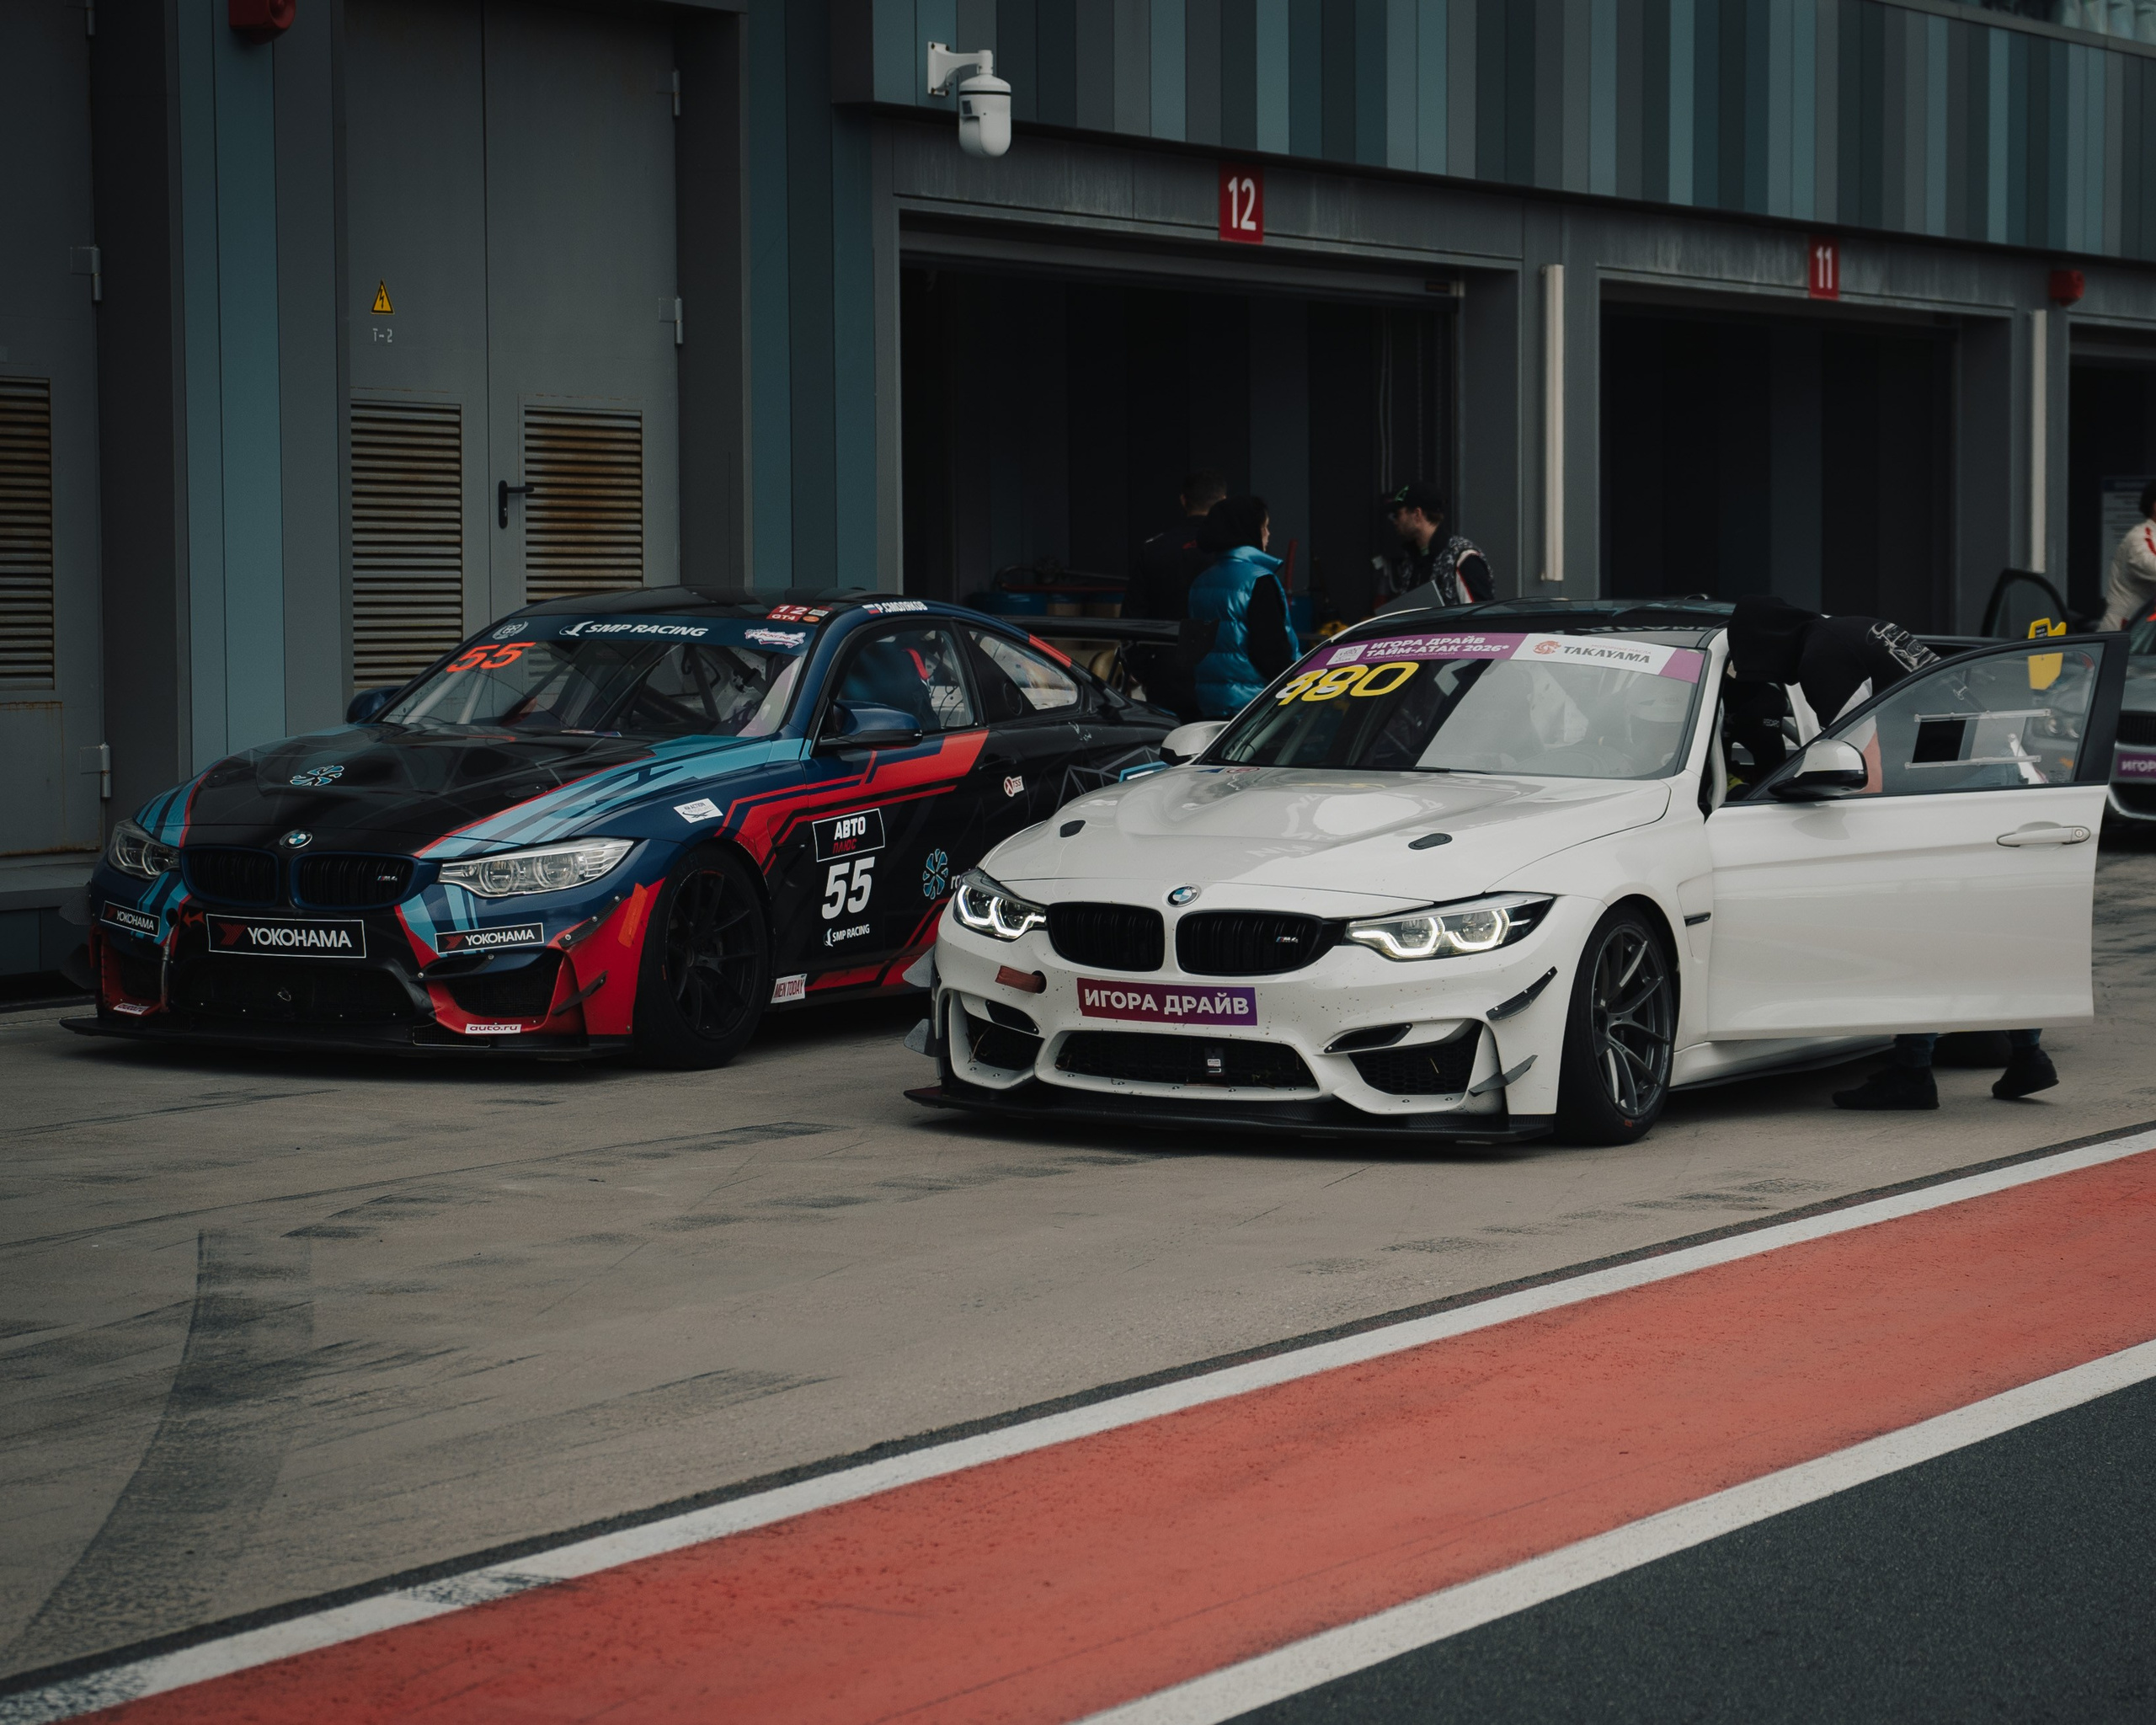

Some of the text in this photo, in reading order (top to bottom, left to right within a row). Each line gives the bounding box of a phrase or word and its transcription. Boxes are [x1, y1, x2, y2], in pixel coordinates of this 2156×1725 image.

[1227, 175, 1257, 232] 12
[1816, 244, 1833, 290] 11
[778, 605, 808, 616] 12
[584, 624, 709, 637] SMP RACING
[1366, 644, 1460, 657] ТАЙМ-АТАК
[1370, 635, 1486, 649] ИГОРА ДРАЙВ
[446, 641, 537, 673] 55
[1563, 646, 1651, 664] TAKAYAMA
[2121, 760, 2156, 772] ИГОР
[834, 815, 867, 841] АВТО
[832, 838, 857, 854] ПЛЮС
[821, 856, 876, 920] 55
[116, 910, 154, 931] YOKOHAMA
[247, 927, 353, 948] YOKOHAMA
[465, 928, 536, 946] YOKOHAMA
[832, 923, 870, 943] SMP RACING
[774, 979, 805, 998] MEN TODAY
[1084, 988, 1250, 1016] ИГОРА ДРАЙВ
